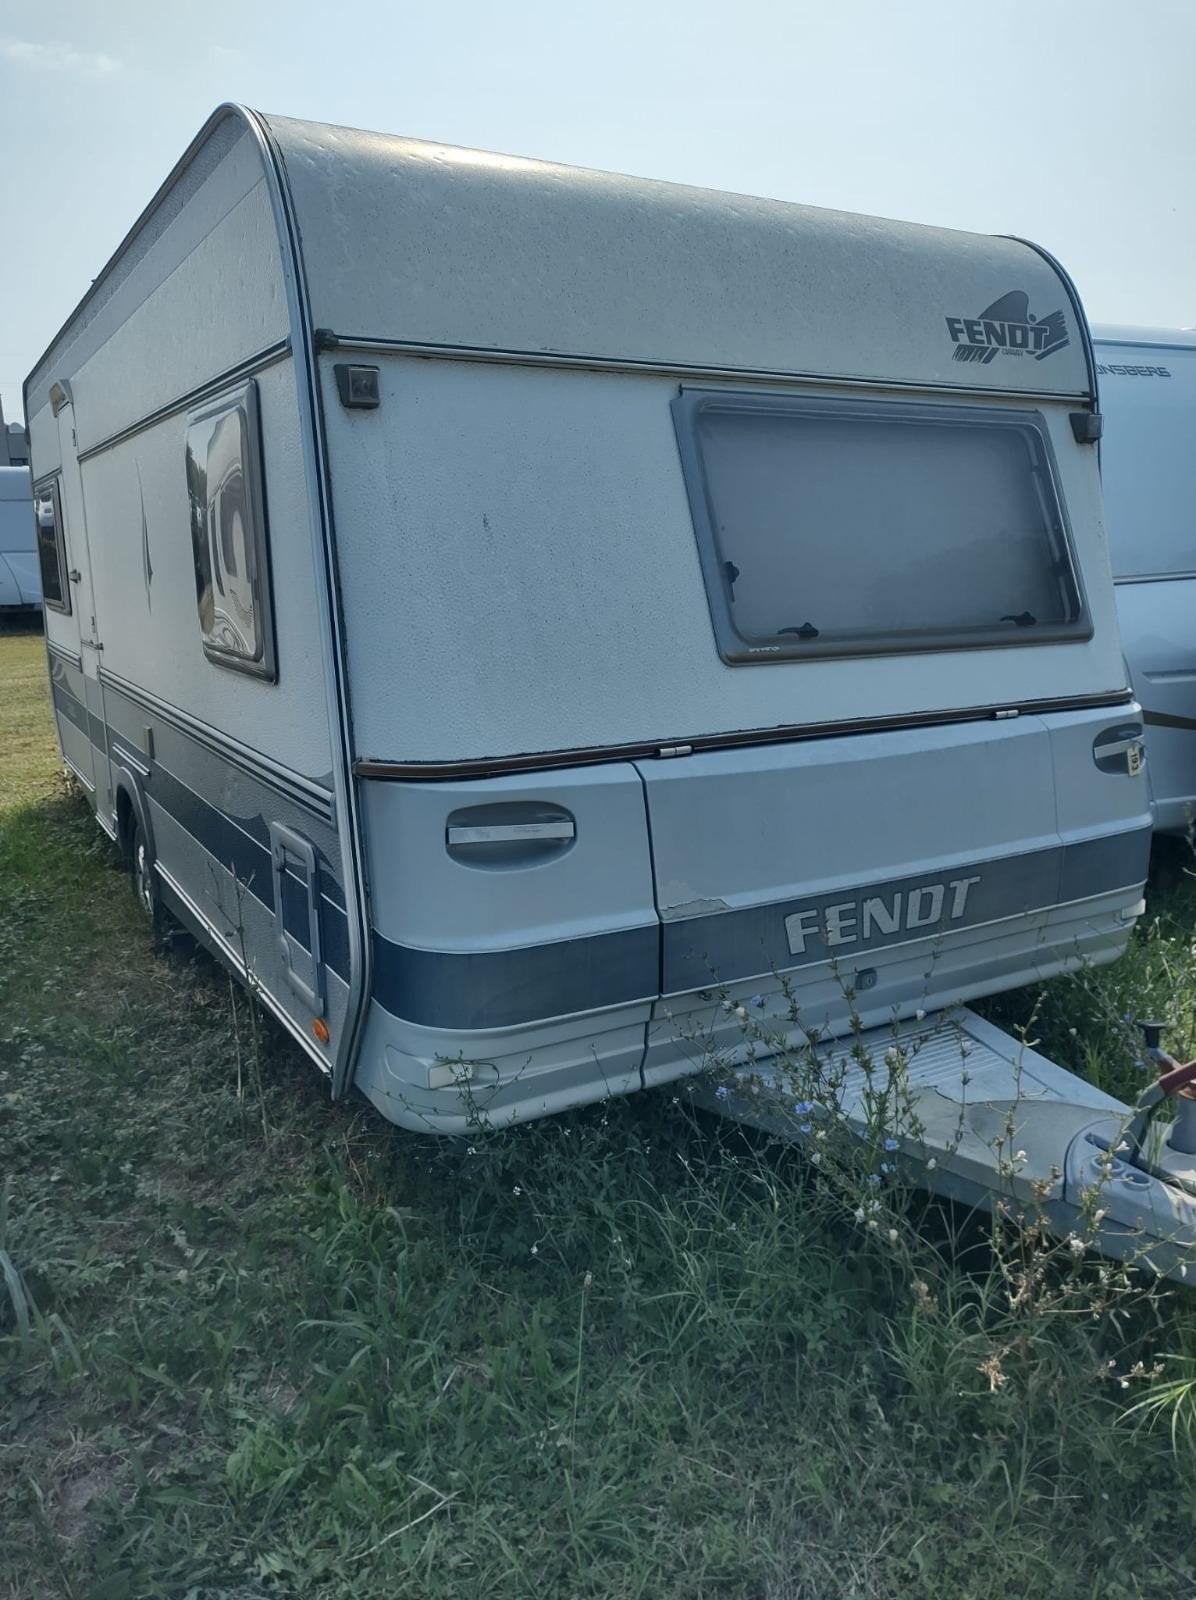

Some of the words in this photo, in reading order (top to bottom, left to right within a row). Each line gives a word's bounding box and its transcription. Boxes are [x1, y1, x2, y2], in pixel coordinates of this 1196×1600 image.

[945, 317, 1049, 349] FENDT
[1096, 364, 1171, 377] INSBERG
[785, 876, 981, 955] FENDT
